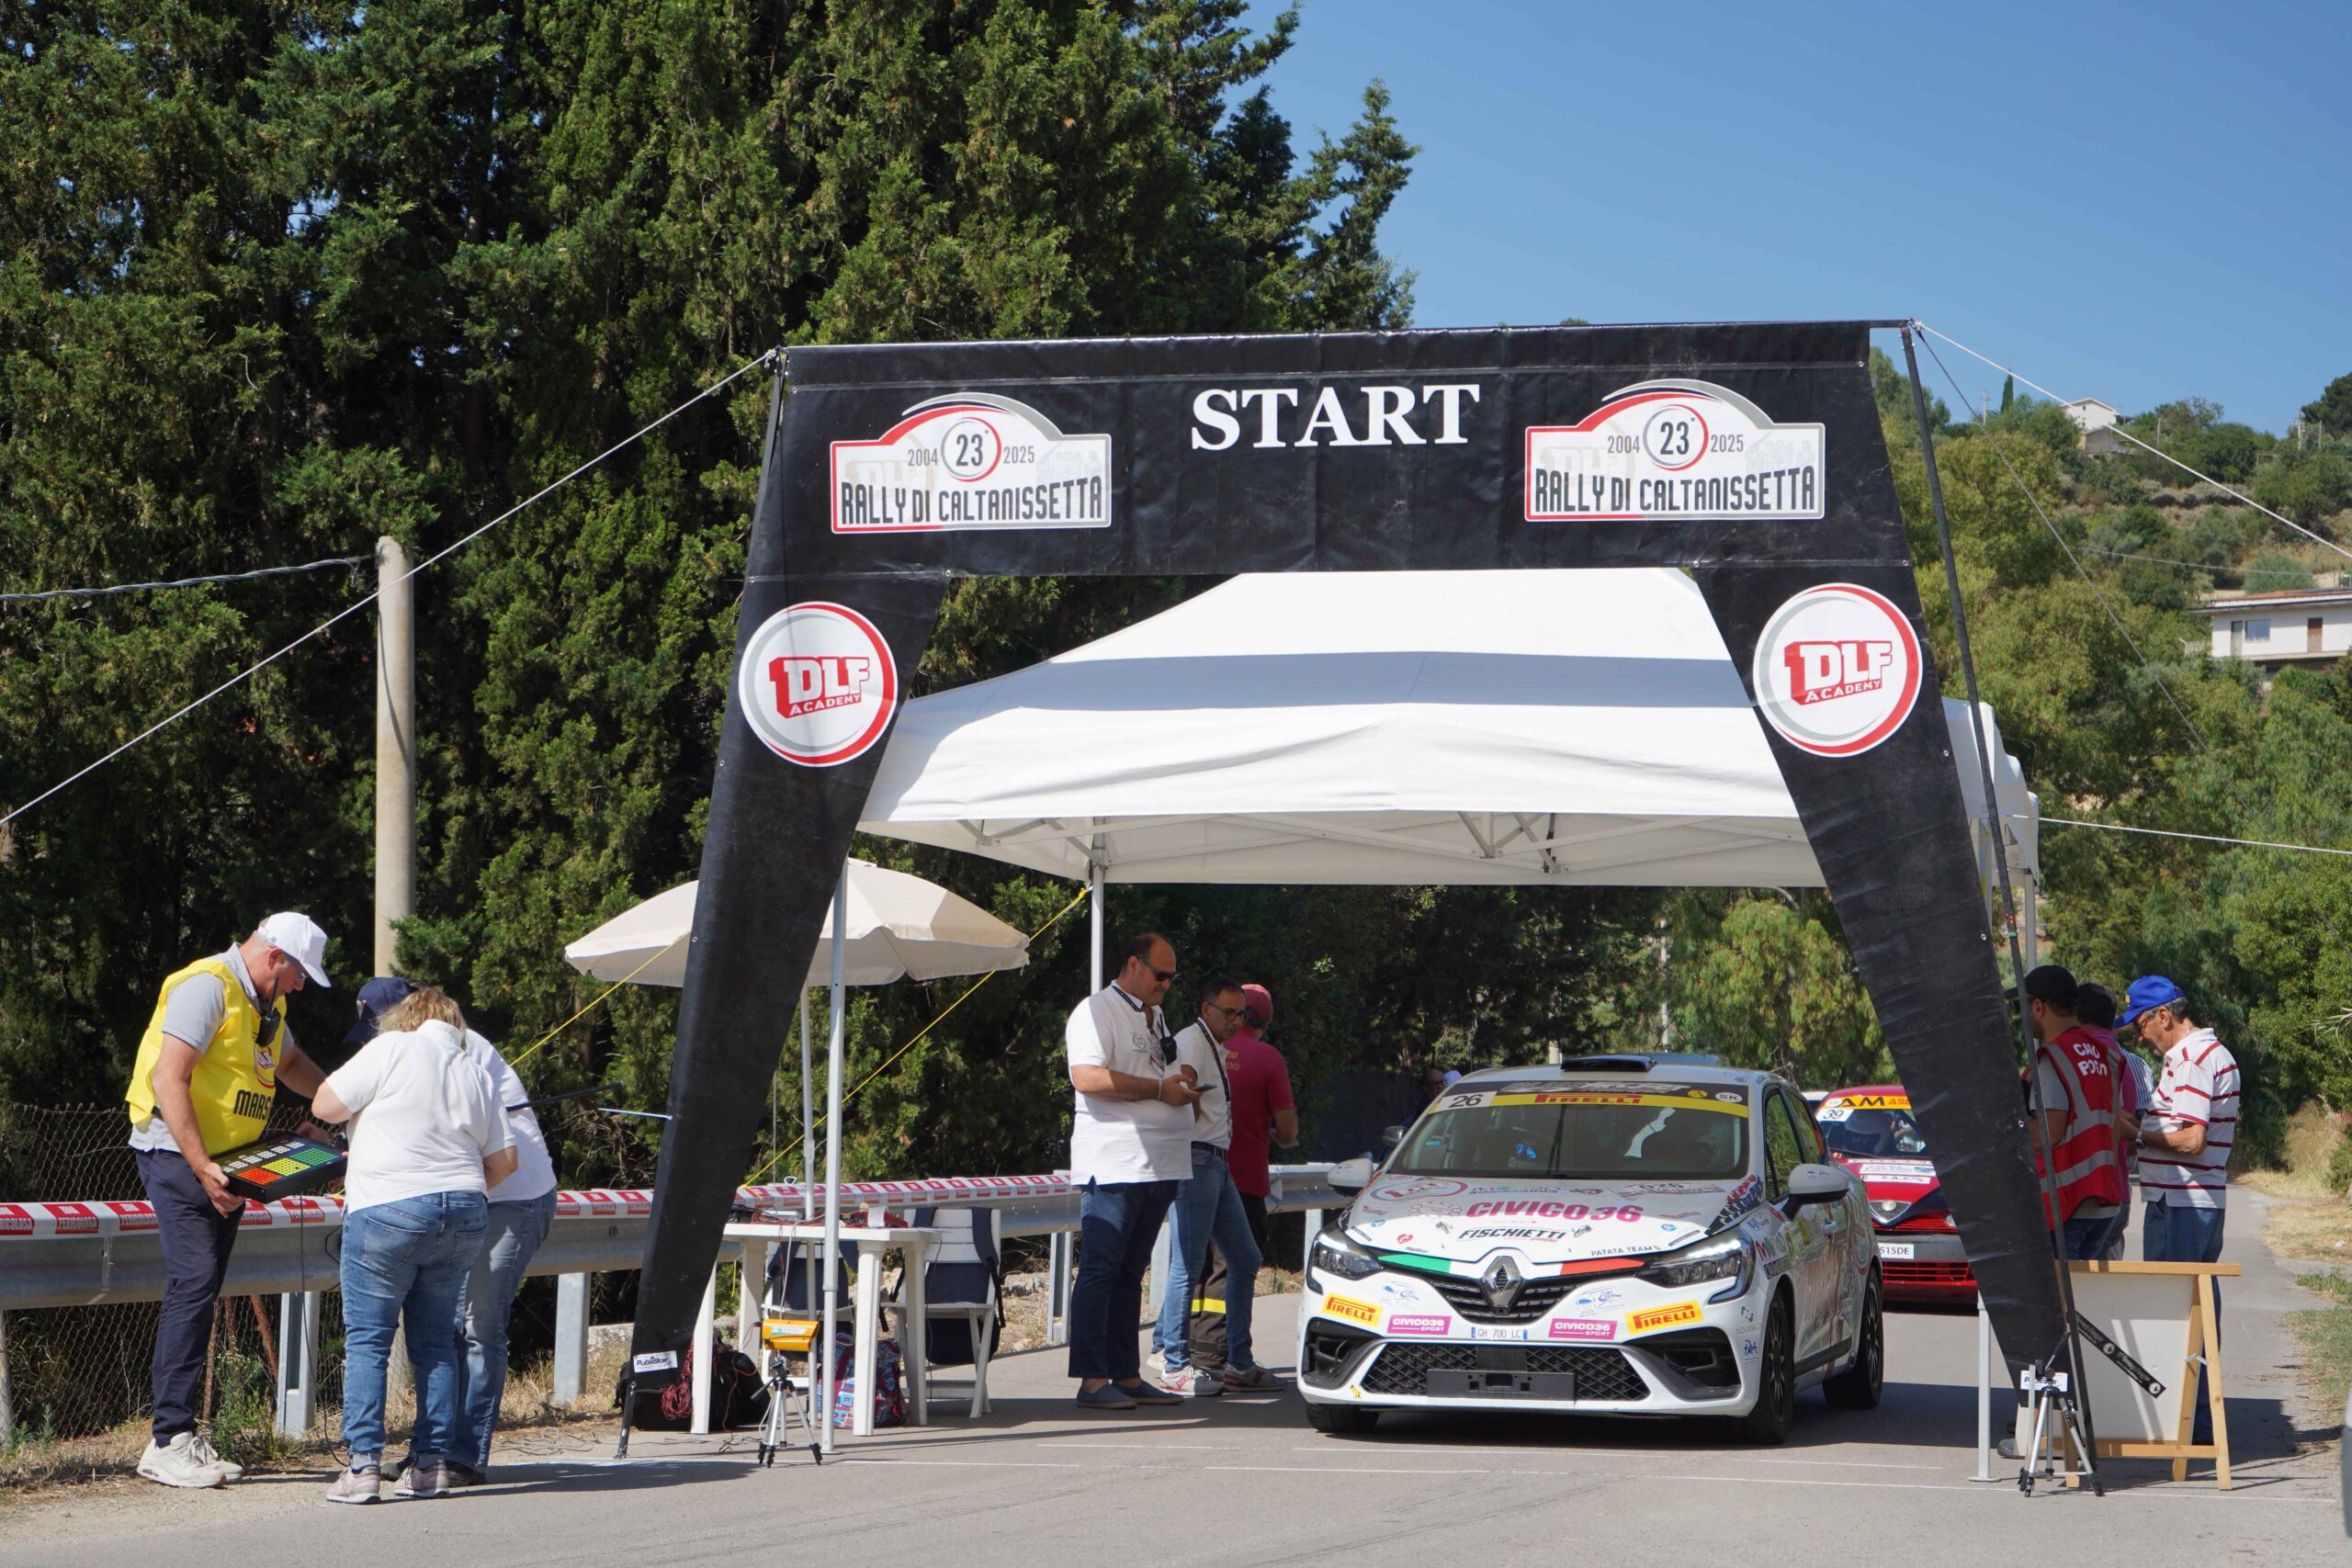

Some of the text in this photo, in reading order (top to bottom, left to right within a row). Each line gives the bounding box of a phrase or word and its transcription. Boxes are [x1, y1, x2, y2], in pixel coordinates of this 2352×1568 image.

[1192, 384, 1480, 450] START
[1608, 435, 1640, 454] 2004
[1711, 434, 1744, 453] 2025
[908, 448, 939, 467] 2004
[1003, 446, 1035, 464] 2025
[1535, 466, 1815, 512] RALLY DI CALTANISSETTA
[842, 476, 1102, 525] RALLY DI CALTANISSETTA
[1804, 680, 1882, 703] ACADEMY
[789, 694, 862, 716] ACADEMY
[1447, 1093, 1482, 1109] 26
[1533, 1093, 1643, 1104] PIRELLI
[1718, 1093, 1739, 1101] SK
[1823, 1109, 1844, 1120] 39
[1458, 1228, 1566, 1240] FISCHIETTI
[1591, 1245, 1653, 1257] PATATA TEAM
[1327, 1297, 1376, 1322] PIRELLI
[1633, 1304, 1696, 1329] PIRELLI
[1392, 1318, 1445, 1327] CIVICO36
[1555, 1321, 1611, 1331] CIVICO36
[1477, 1329, 1521, 1338] GH 700 LC
